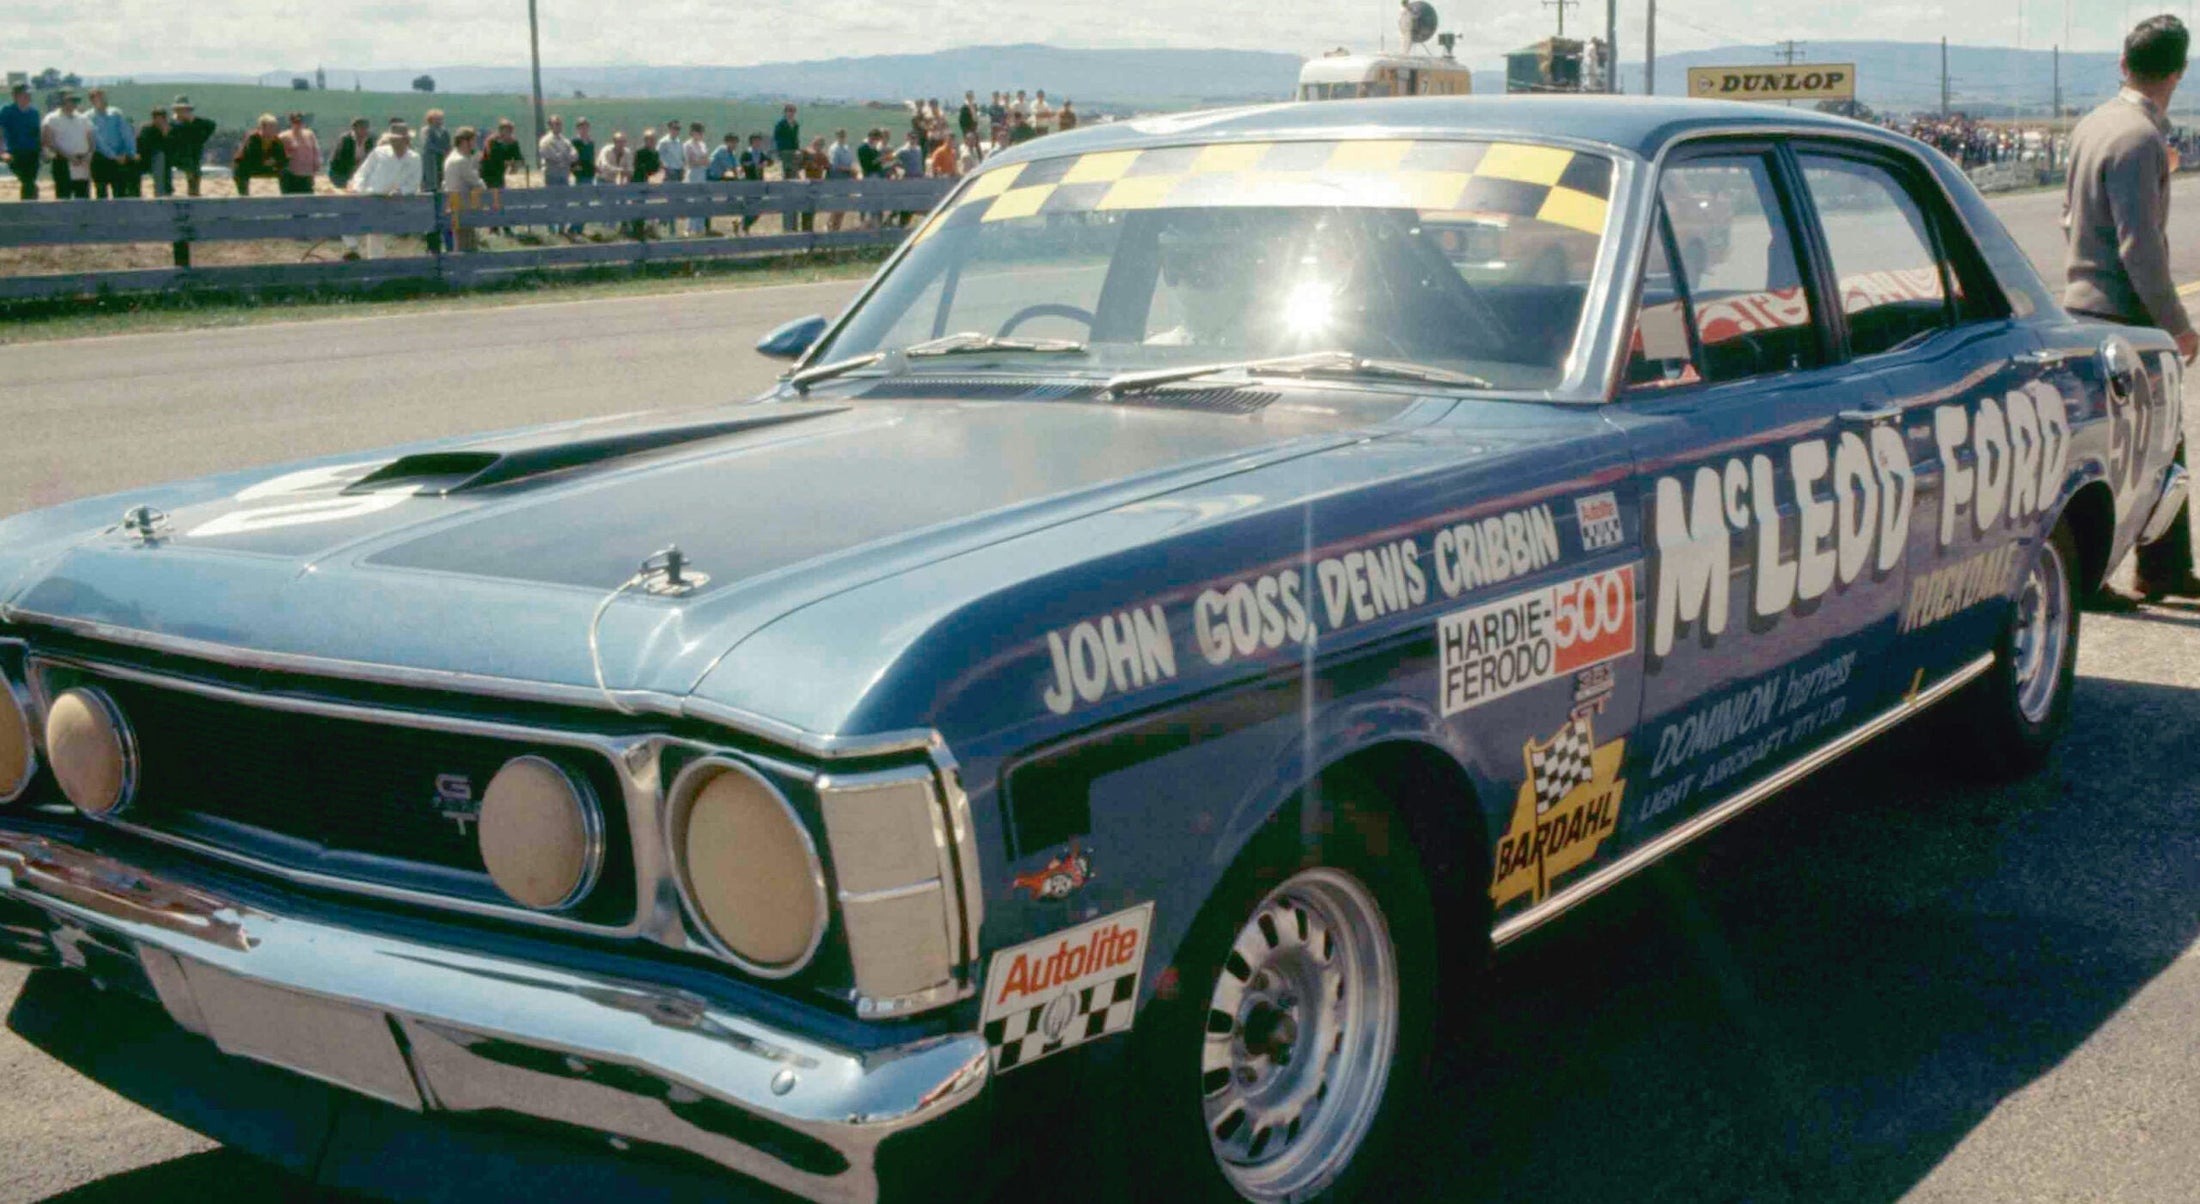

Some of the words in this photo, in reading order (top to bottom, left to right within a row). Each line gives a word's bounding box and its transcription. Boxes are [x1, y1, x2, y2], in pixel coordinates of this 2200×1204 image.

[1720, 72, 1844, 92] DUNLOP
[1934, 380, 2070, 546] FORD
[1044, 603, 1177, 715] JOHN
[1195, 569, 1318, 666] GOSS,
[1316, 537, 1428, 629] DENIS
[1434, 502, 1561, 598] CRIBBIN
[1553, 570, 1627, 648] 500
[1446, 636, 1552, 708] FERODO
[1650, 674, 1782, 778] DOMINION
[1779, 650, 1857, 716] harness
[1639, 764, 1697, 823] LIGHT
[1698, 725, 1788, 792] AIRCRAFT
[1818, 696, 1847, 727] LTD
[1496, 790, 1613, 880] BARDAHL
[996, 922, 1139, 1006] Autolite
